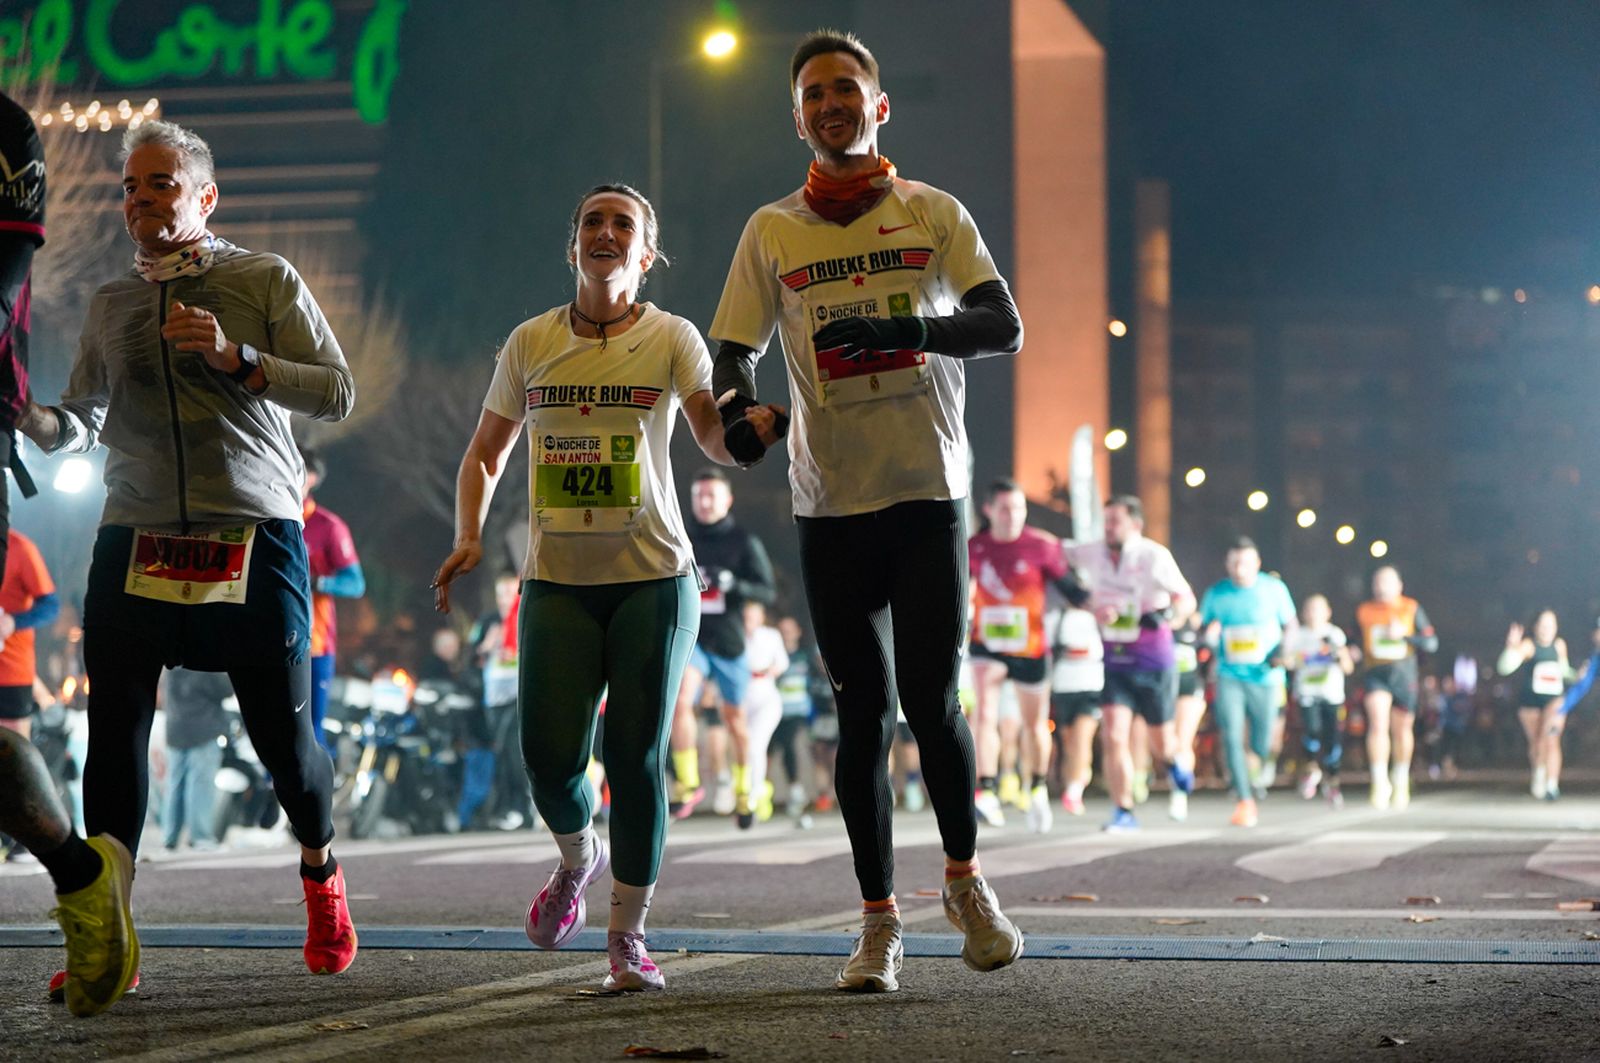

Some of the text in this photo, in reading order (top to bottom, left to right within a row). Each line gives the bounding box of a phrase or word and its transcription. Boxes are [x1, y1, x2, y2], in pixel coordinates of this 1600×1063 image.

[84, 0, 337, 85] Corte
[807, 249, 903, 281] TRUEKE RUN
[828, 304, 863, 320] NOCHE
[865, 302, 878, 317] DE
[540, 385, 632, 403] TRUEKE RUN
[556, 439, 587, 450] NOCHE
[588, 439, 601, 450] DE
[543, 452, 567, 465] SAN
[567, 449, 602, 464] ANTÓN
[561, 465, 614, 497] 424
